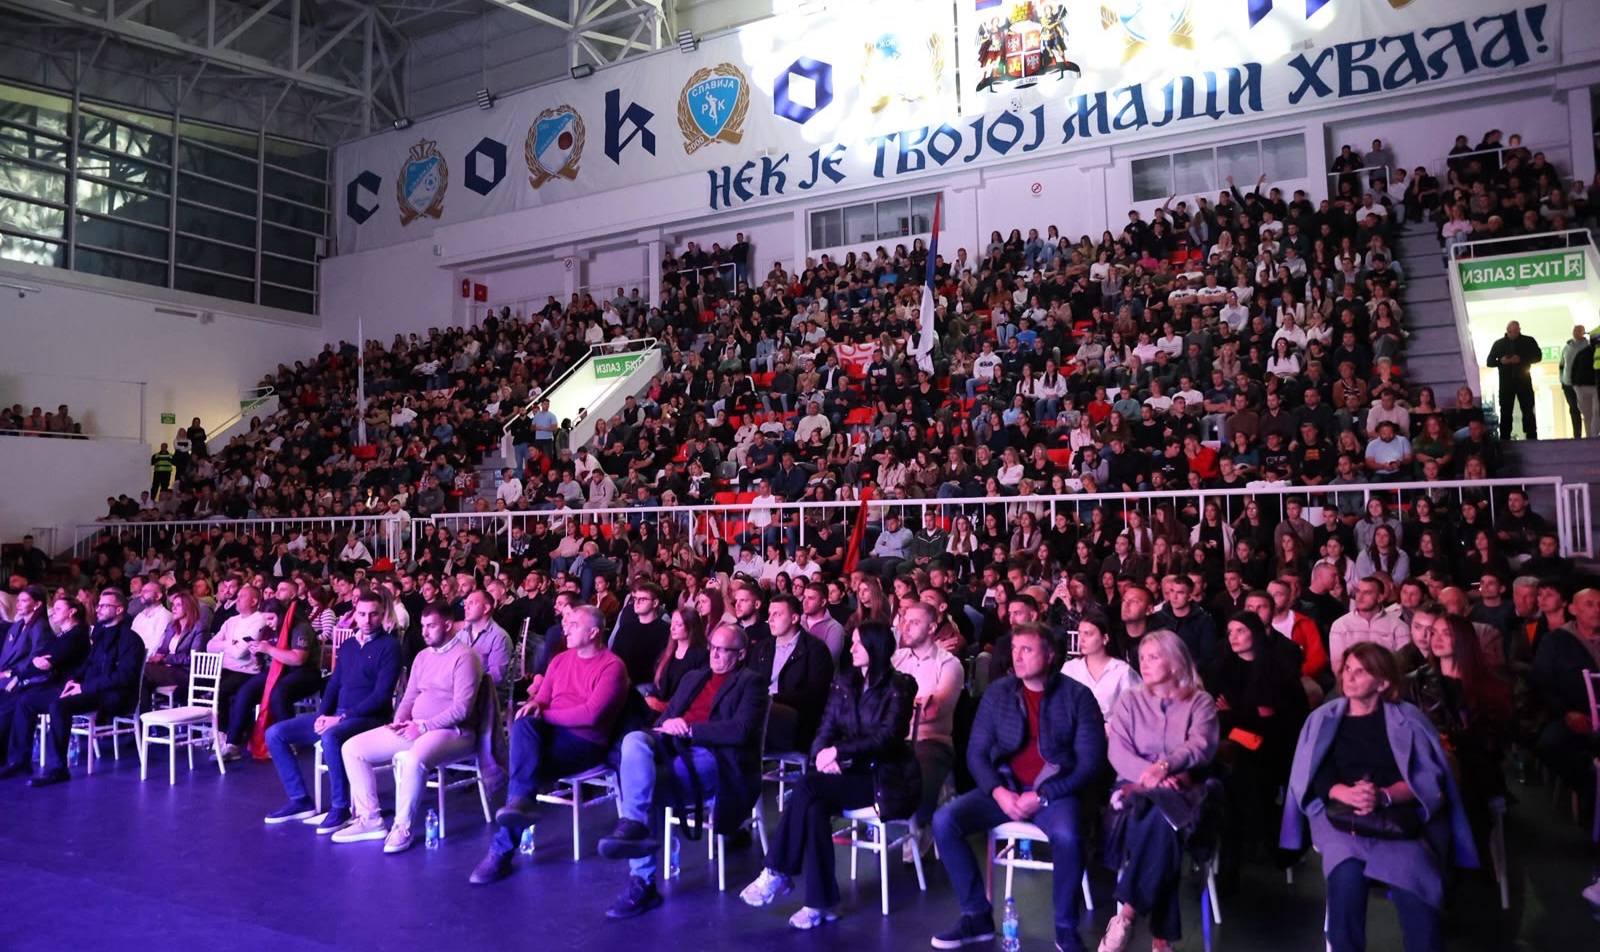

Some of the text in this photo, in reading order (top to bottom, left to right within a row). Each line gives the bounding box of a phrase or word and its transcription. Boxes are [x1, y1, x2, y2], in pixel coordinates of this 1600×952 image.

[691, 79, 735, 97] СЛАВИЈА
[707, 3, 1549, 211] НЕК ЈЕ ТВОЈОЈ МАЈЦИ ХВАЛА!
[1462, 259, 1563, 285] ИЗЛАЗ EXIT
[596, 361, 621, 374] ИЗЛАЗ
